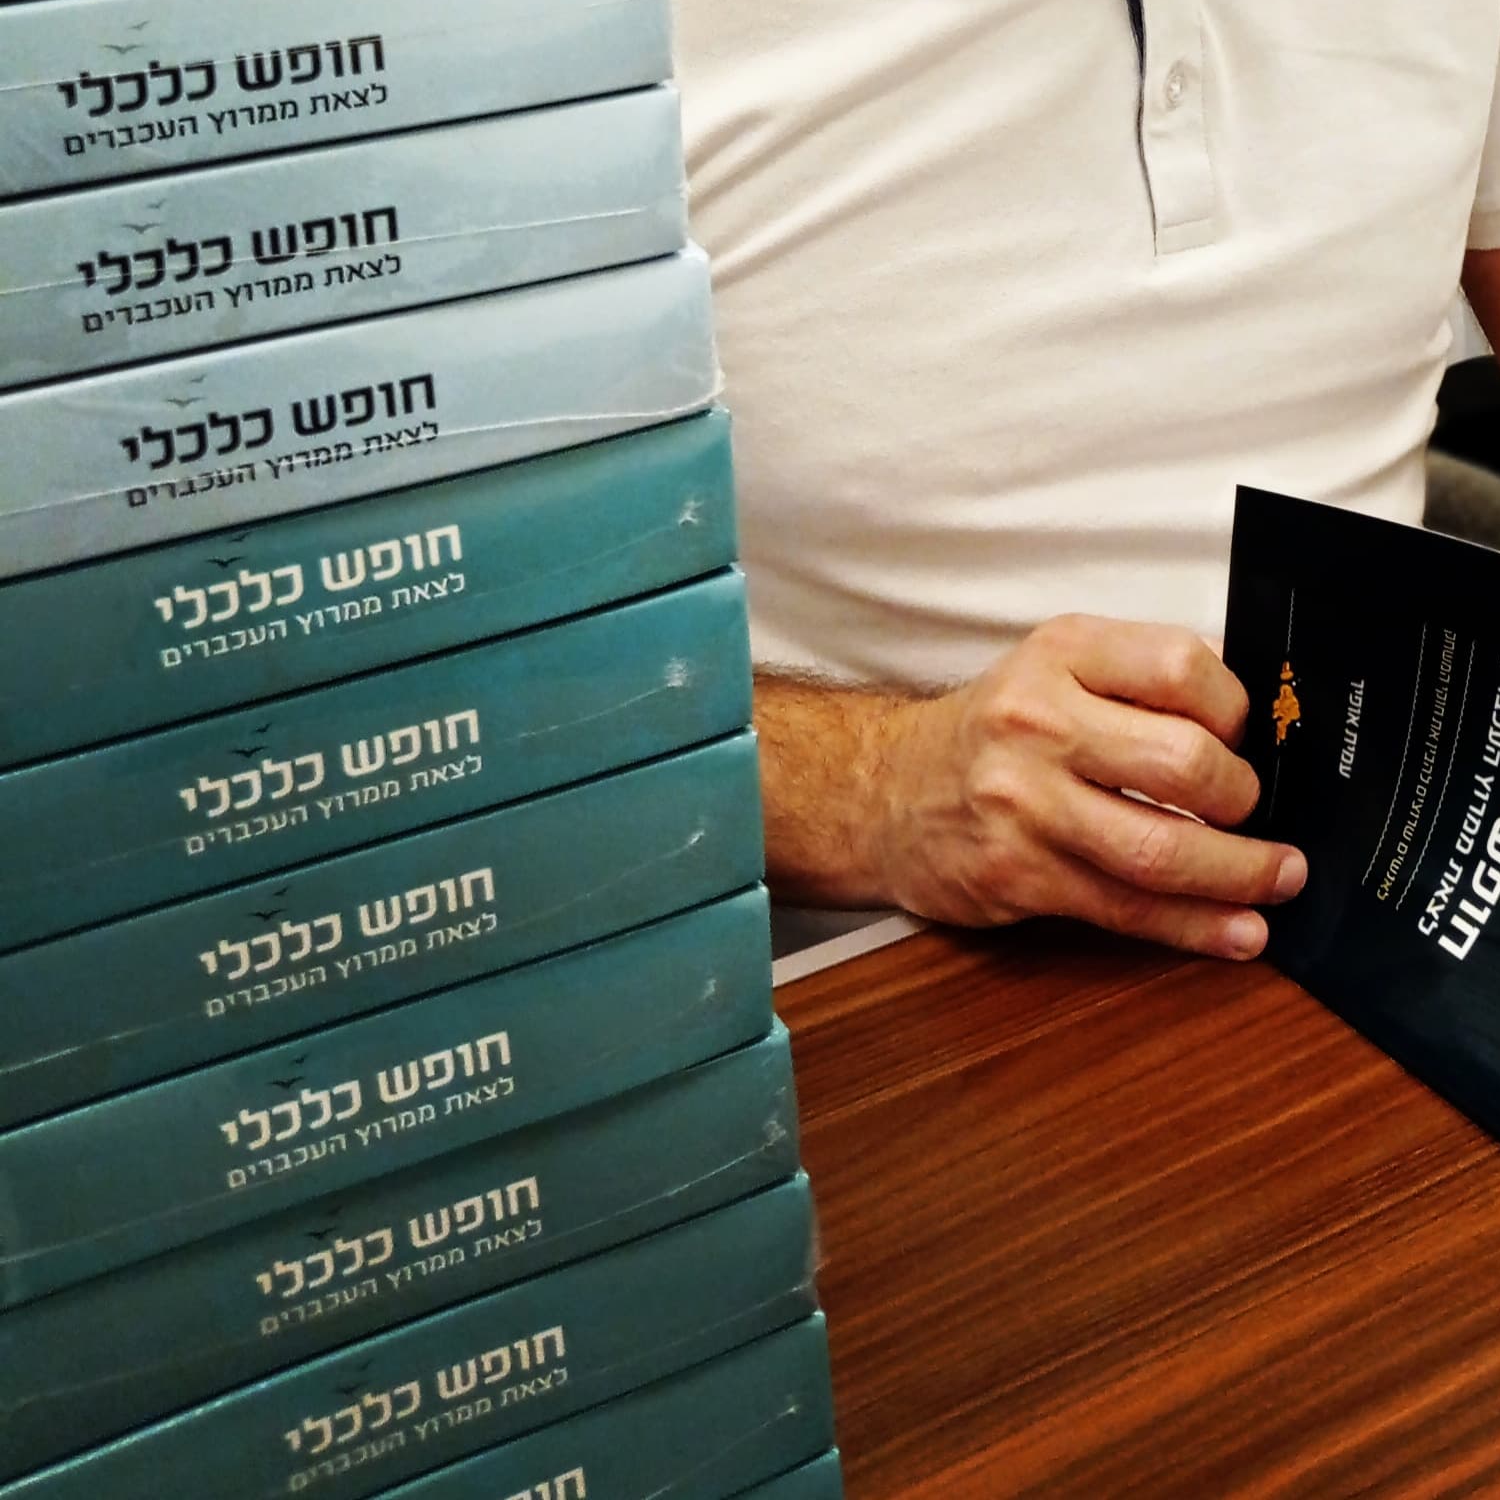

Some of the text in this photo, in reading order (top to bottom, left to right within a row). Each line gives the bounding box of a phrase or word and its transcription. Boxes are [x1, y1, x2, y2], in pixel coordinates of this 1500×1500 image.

[58, 35, 384, 118] חופש כלכלי
[64, 83, 387, 157] לצאת ממרוץ העכברים
[77, 206, 398, 296] חופש כלכלי
[82, 254, 400, 334] לצאת ממרוץ העכברים
[121, 374, 435, 470] חופש כלכלי
[155, 524, 461, 628] חופש כלכלי
[161, 573, 464, 668] לצאת ממרוץ העכברים
[180, 709, 479, 818] חופש כלכלי
[1339, 680, 1364, 778] עמית אופיר
[1377, 630, 1456, 900] לאנשים שרוצים להבין את חוקי המשחק
[186, 755, 481, 856] לצאת ממרוץ העכברים
[1418, 858, 1463, 935] לצאת
[1456, 775, 1492, 854] ממרוץ
[199, 867, 494, 979] חופש כלכלי
[206, 913, 496, 1018] לצאת ממרוץ העכברים
[220, 1031, 510, 1148] חופש כלכלי
[256, 1176, 538, 1297] חופש כלכלי
[285, 1325, 565, 1452] חופש כלכלי
